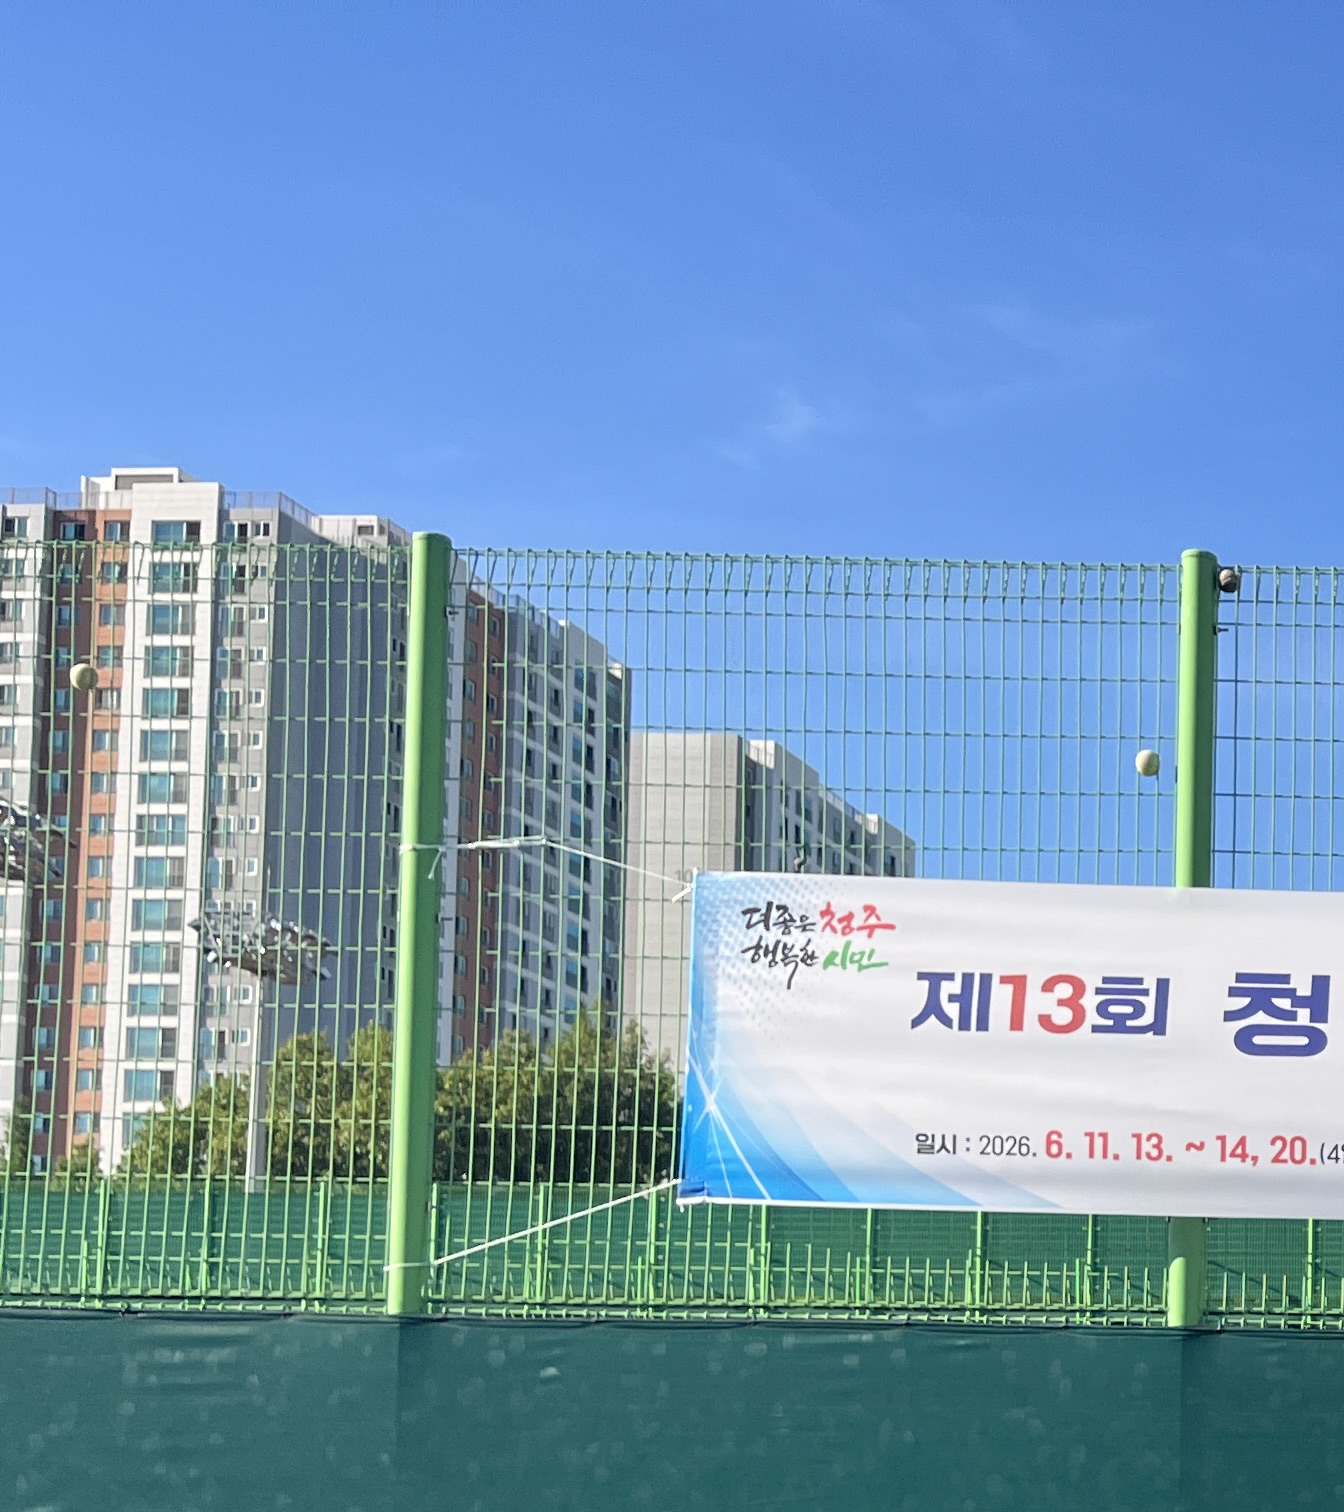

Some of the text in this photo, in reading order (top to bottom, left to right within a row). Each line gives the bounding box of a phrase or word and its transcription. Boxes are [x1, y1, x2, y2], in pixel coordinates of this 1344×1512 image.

[820, 901, 896, 939] 청주
[741, 935, 889, 990] 행복한 시민
[910, 971, 1171, 1037] 제13회
[979, 1134, 1037, 1158] 2026.
[1045, 1129, 1073, 1160] 6.
[1083, 1131, 1120, 1161] 11.
[1131, 1132, 1173, 1163] 13.
[1215, 1134, 1259, 1167] 14,
